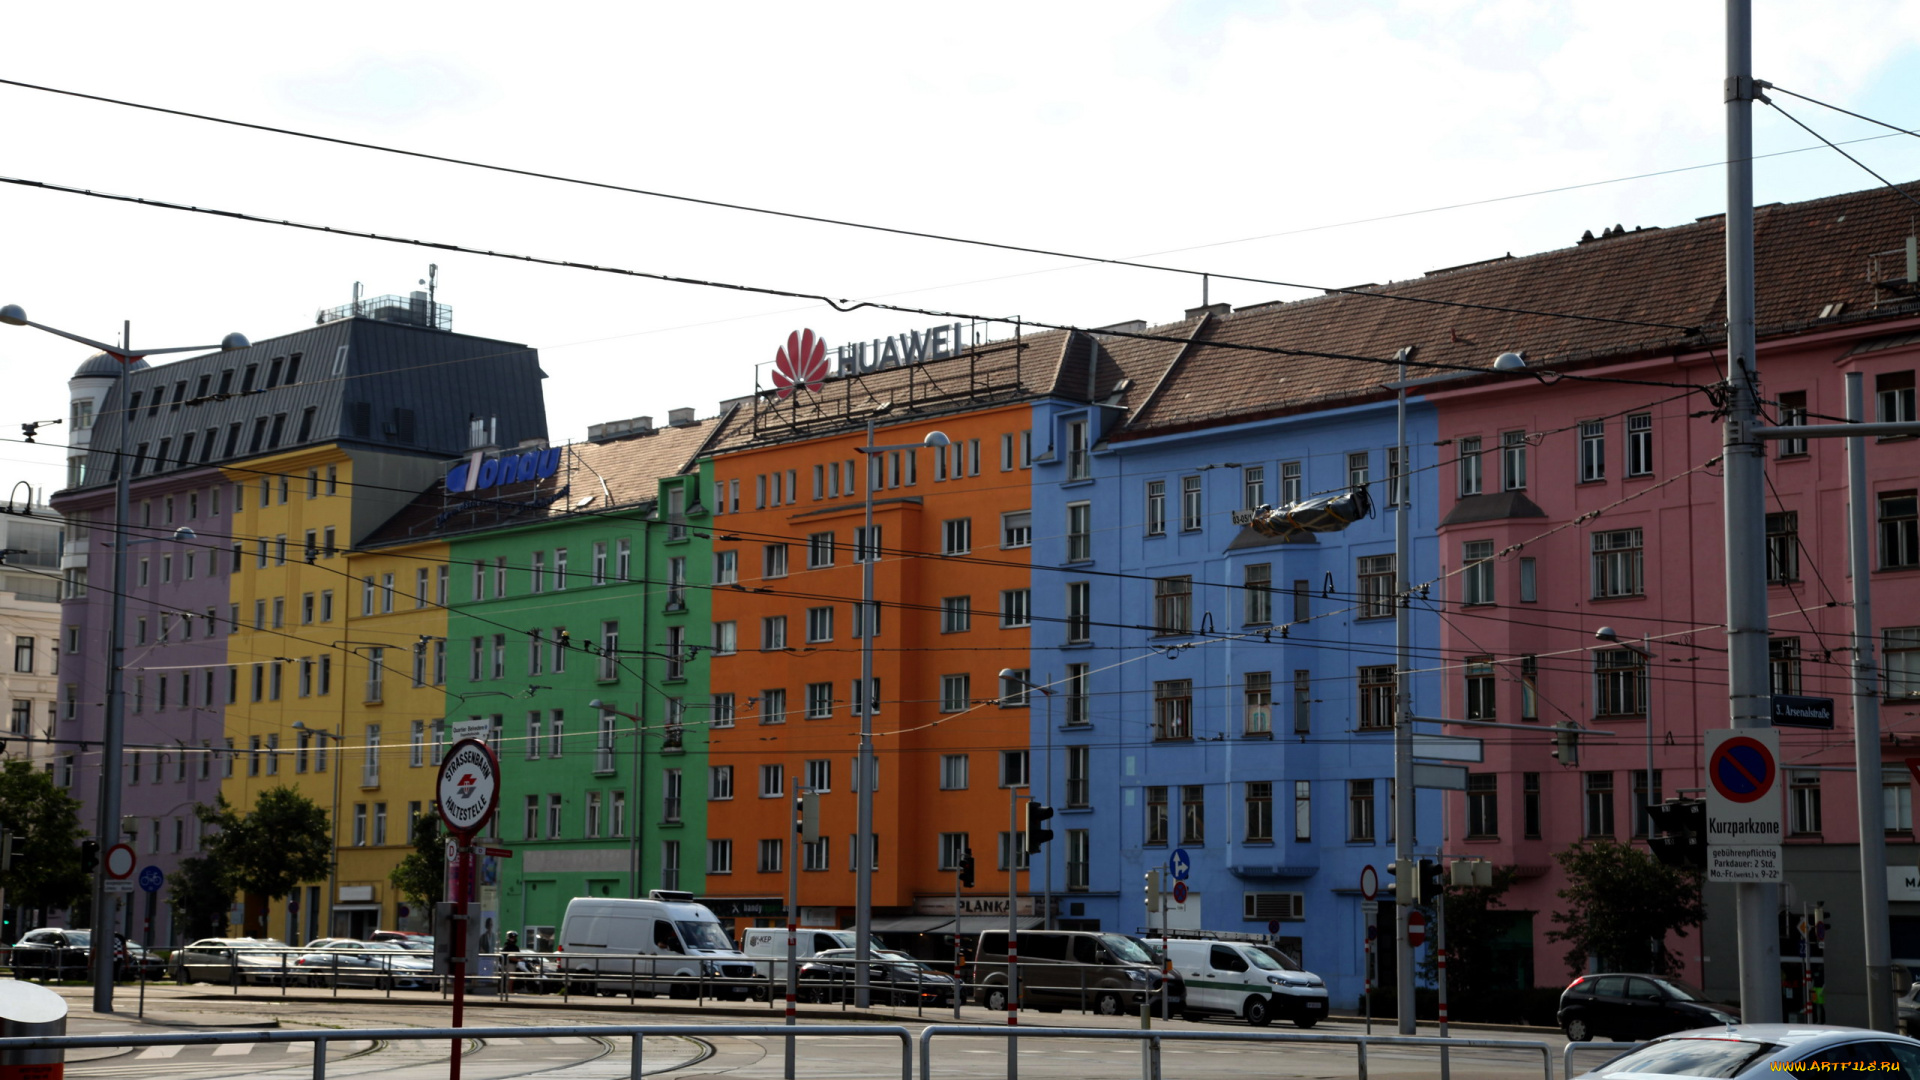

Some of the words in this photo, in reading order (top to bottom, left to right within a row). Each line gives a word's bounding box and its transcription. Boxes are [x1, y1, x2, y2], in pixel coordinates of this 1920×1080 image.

[838, 322, 962, 378] HUAWEI
[1785, 704, 1830, 720] Arsenalstraße
[445, 750, 491, 782] STRASSENBAHN
[445, 793, 488, 821] HALTESTELLE
[1709, 817, 1780, 838] Kurzparkzone
[449, 845, 455, 857] D
[1712, 848, 1777, 859] gebührenpflichtig
[1714, 859, 1753, 868] Parkdauer:
[1754, 859, 1759, 868] 2
[1760, 859, 1775, 868] Std.
